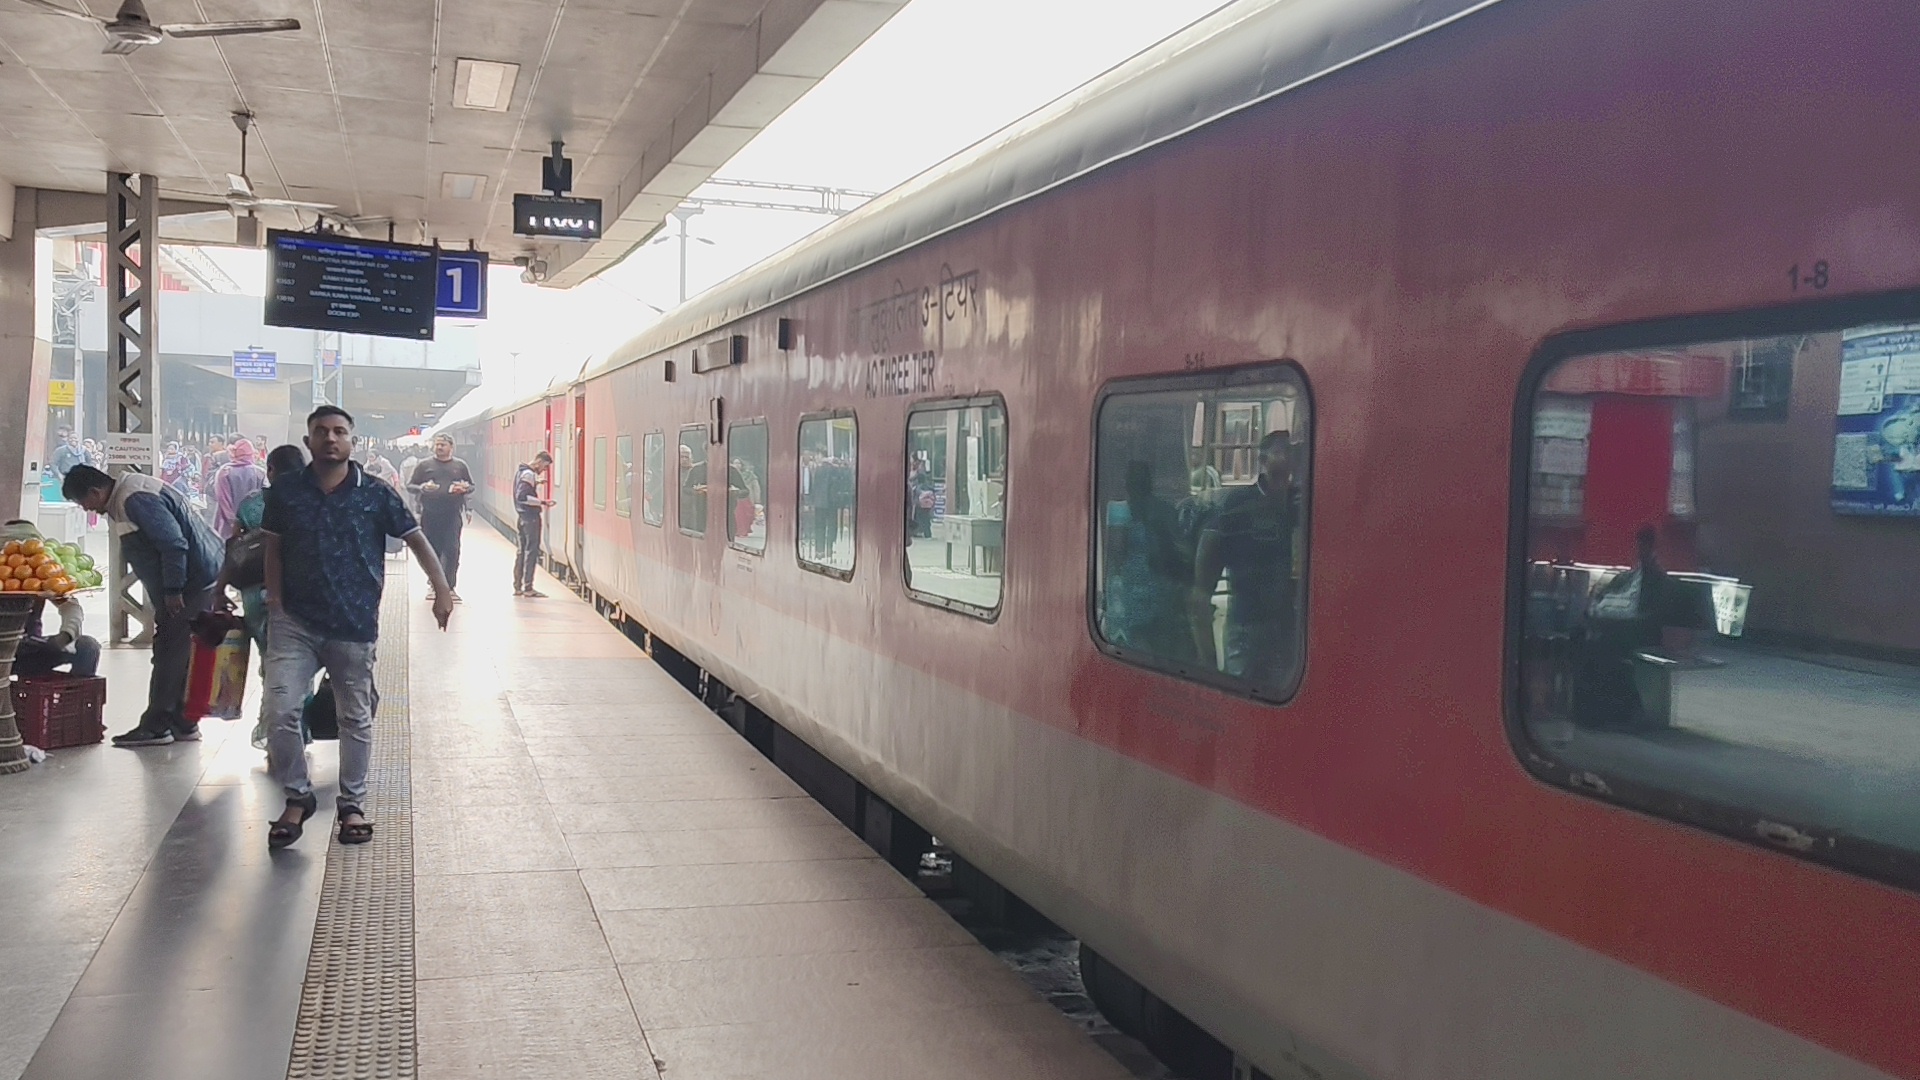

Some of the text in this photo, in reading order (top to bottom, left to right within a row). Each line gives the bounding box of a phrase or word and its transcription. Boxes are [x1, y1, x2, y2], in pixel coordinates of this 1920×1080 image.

[446, 267, 462, 302] 1
[1787, 261, 1829, 291] 1-8
[864, 349, 936, 400] AC THREE TIER
